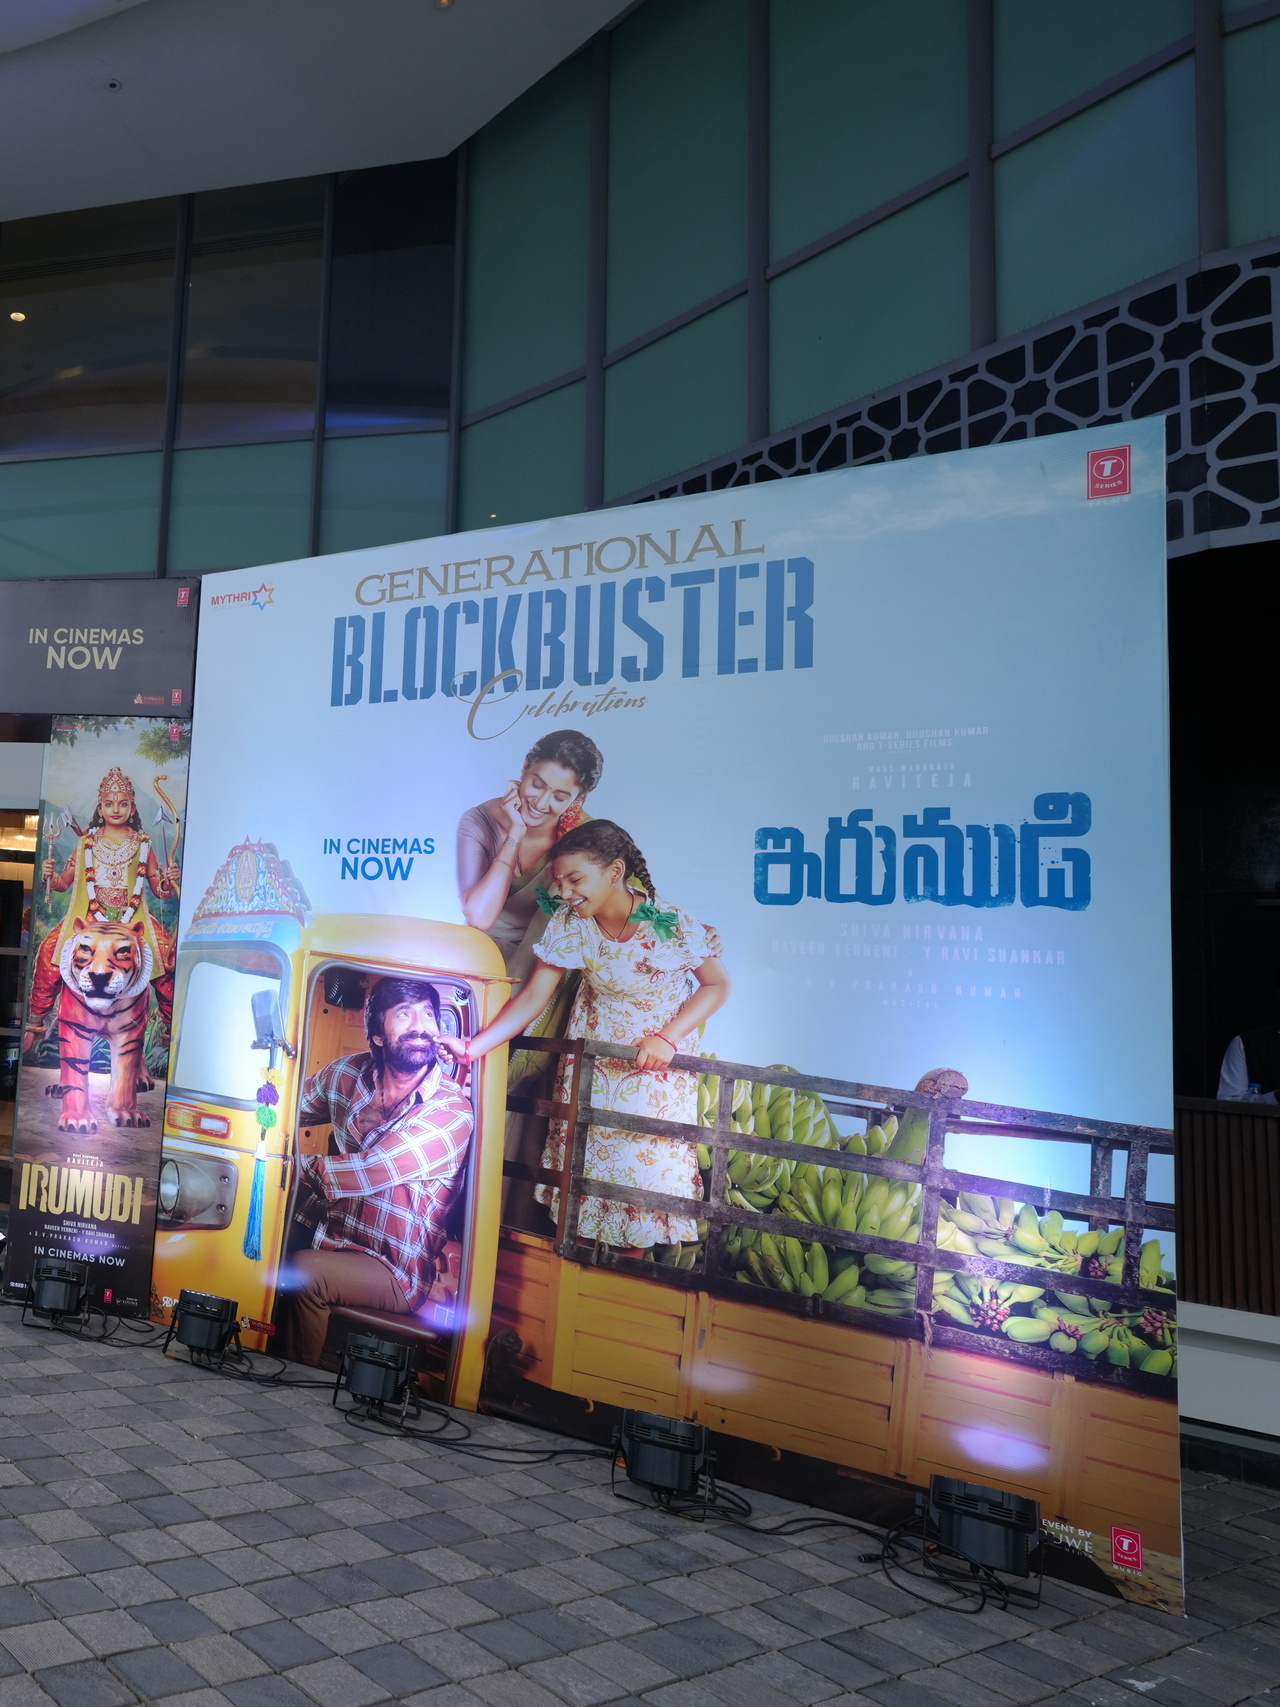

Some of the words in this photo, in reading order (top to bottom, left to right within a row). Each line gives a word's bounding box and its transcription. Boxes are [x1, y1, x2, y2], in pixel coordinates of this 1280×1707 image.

[1094, 480, 1124, 489] SERIES
[354, 518, 765, 607] GENERATIONAL
[210, 591, 251, 606] MYTHRI
[28, 628, 48, 644] IN
[53, 627, 145, 645] CINEMAS
[329, 556, 815, 707] BLOCKBUSTER
[46, 646, 123, 670] NOW
[450, 668, 646, 741] Celebrations
[823, 733, 864, 743] GULSHAN
[906, 728, 952, 739] BHUSHAN
[954, 726, 989, 736] KUMAR
[856, 741, 875, 751] AND
[878, 739, 920, 750] T-SERIES
[924, 738, 953, 748] FILMS
[868, 764, 894, 773] MASS
[900, 762, 955, 772] MAHARAJA
[852, 772, 972, 790] RAVITEJA
[323, 838, 341, 855] IN
[346, 837, 435, 855] CINEMAS
[340, 856, 414, 881] NOW
[840, 922, 890, 939] SHIVA
[903, 923, 984, 942] NIRVANA
[772, 940, 825, 955] NAVEEN
[834, 942, 898, 959] YERNENI
[924, 946, 932, 960] Y
[941, 946, 978, 963] RAVI
[988, 948, 1065, 966] SHANKAR
[852, 979, 938, 994] PRAKASH
[956, 985, 1021, 999] KUMAR
[66, 1157, 104, 1168] RAVITEJA
[18, 1162, 144, 1225] IRUMUDI
[44, 1224, 60, 1233] NAVEEN
[95, 1231, 115, 1239] SHANKAR
[63, 1219, 76, 1228] SHIVA
[77, 1221, 97, 1230] NIRVANA
[84, 1237, 108, 1246] KUMAR
[34, 1245, 44, 1255] IN
[48, 1247, 95, 1263] CINEMAS
[99, 1255, 125, 1267] NOW
[1041, 1518, 1075, 1534] EVENT
[1078, 1528, 1092, 1538] BY
[1116, 1552, 1137, 1562] SERIES
[1112, 1564, 1143, 1577] MUSIC
